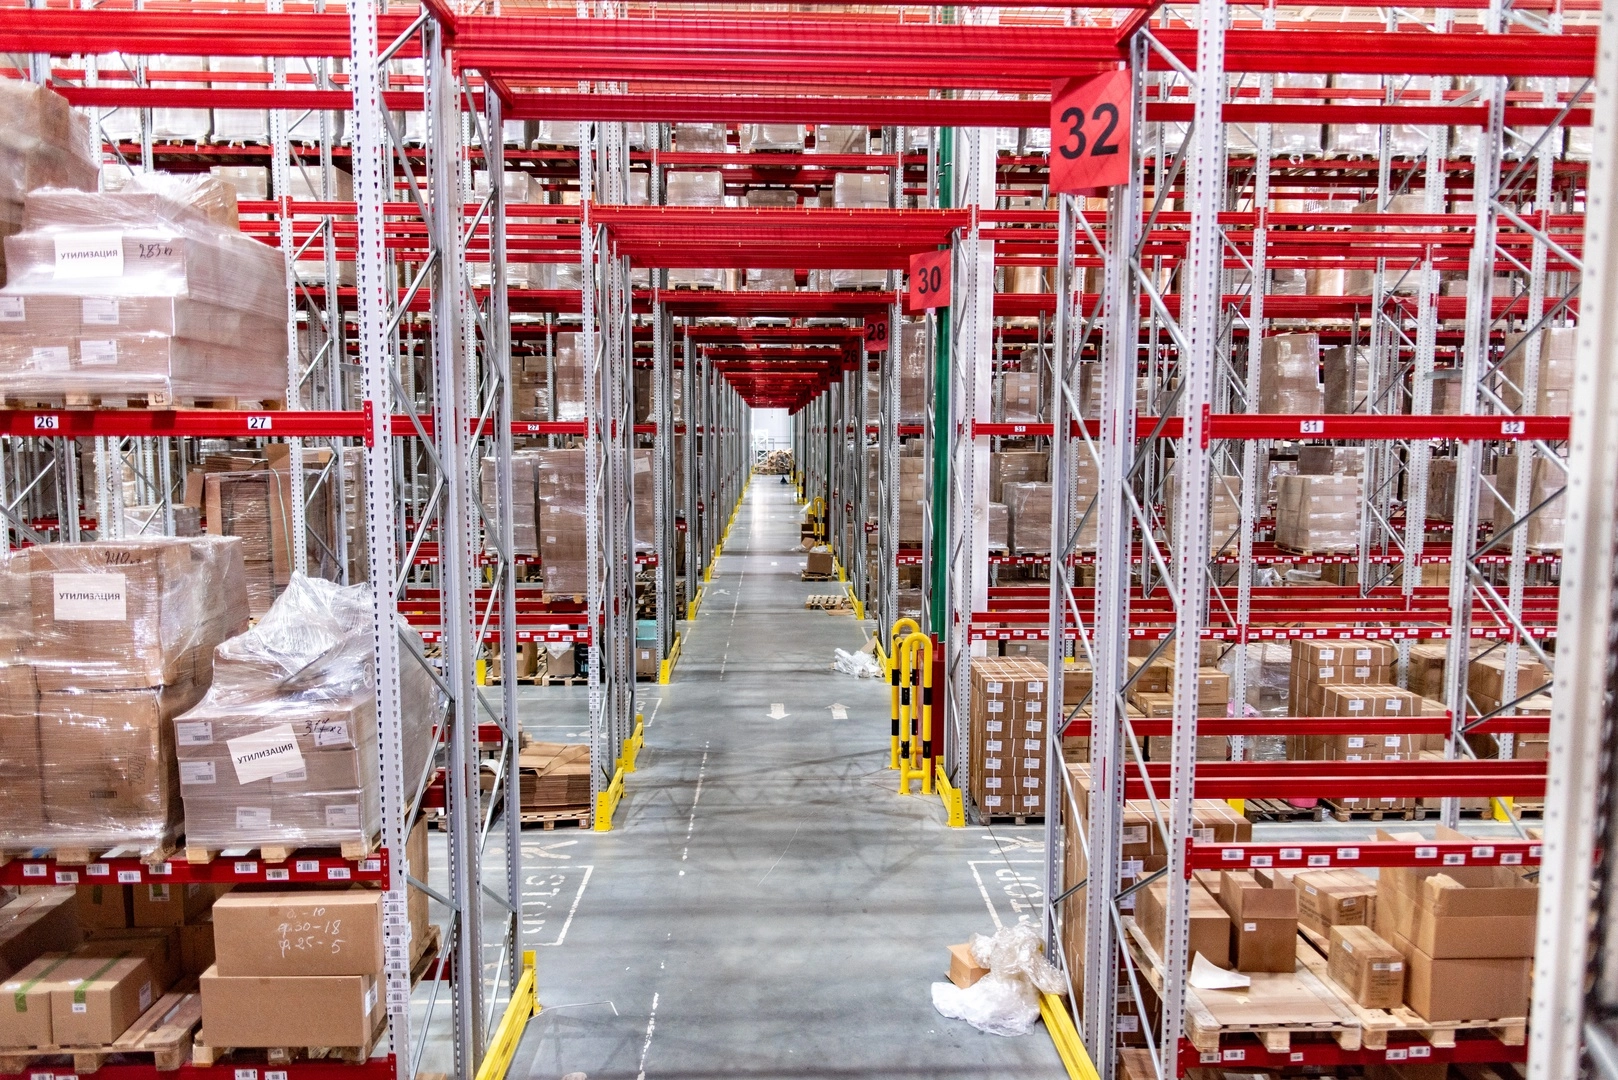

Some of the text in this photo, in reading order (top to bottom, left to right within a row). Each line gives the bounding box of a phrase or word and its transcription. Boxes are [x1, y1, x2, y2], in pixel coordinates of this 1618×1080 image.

[1059, 102, 1119, 160] 32
[60, 249, 118, 261] УТИЛИЗАЦИЯ
[918, 265, 942, 295] 30
[867, 323, 886, 341] 28
[843, 349, 858, 363] 26
[36, 416, 54, 429] 26
[250, 417, 266, 429] 27
[1303, 421, 1318, 432] 31
[1504, 422, 1520, 433] 32
[59, 592, 121, 601] УТИЛИЗАЦИЯ
[237, 743, 294, 765] УТИЛИЗАЦИЯ
[331, 939, 347, 954] 5
